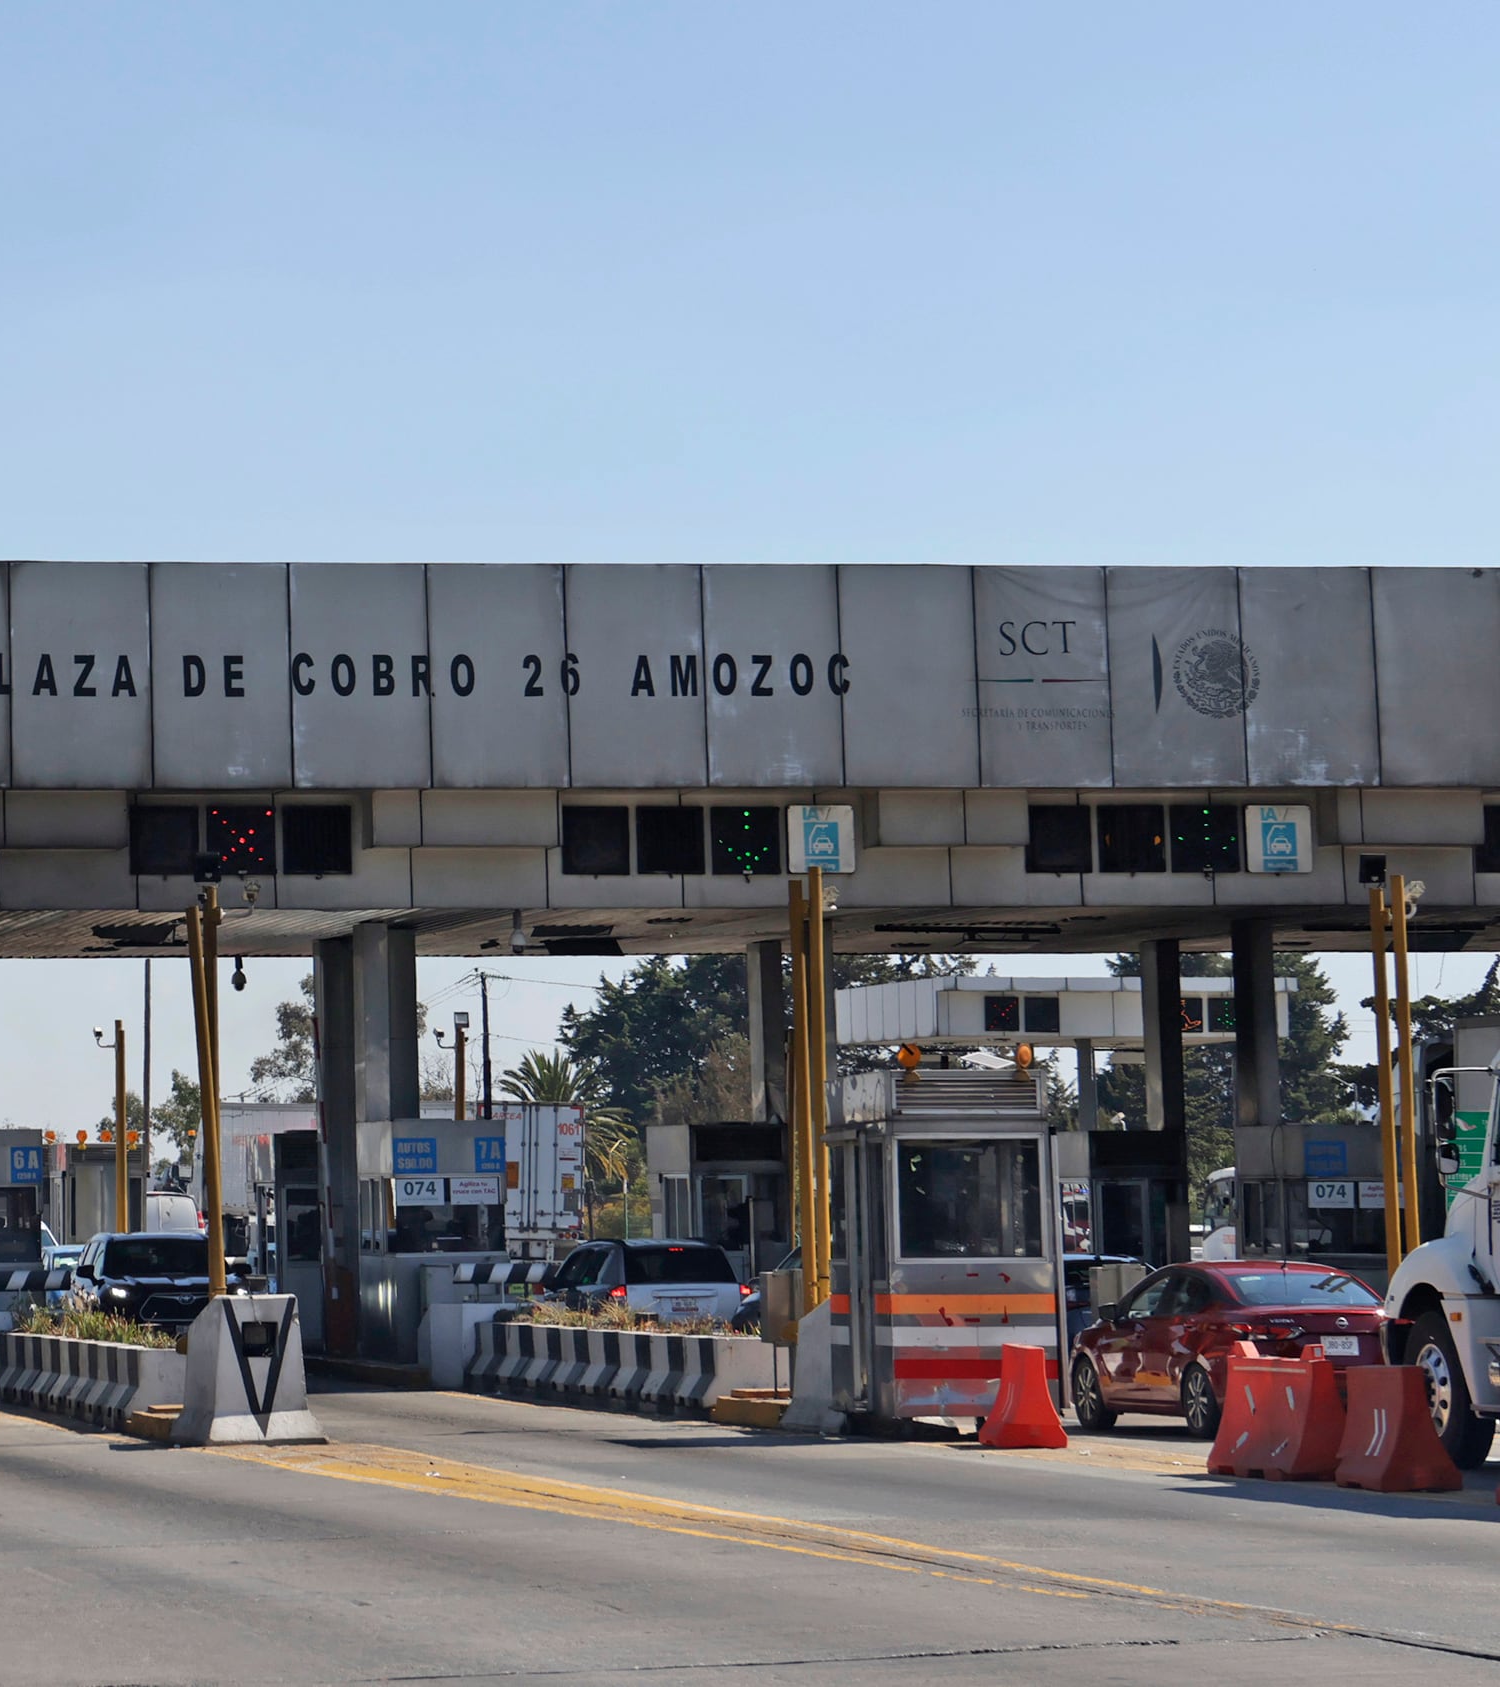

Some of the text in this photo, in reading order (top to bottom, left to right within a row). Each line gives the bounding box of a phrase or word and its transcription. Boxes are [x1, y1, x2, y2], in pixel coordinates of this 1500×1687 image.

[999, 621, 1076, 656] SCT
[182, 654, 245, 698] DE
[292, 653, 476, 698] COBRO
[522, 653, 580, 697] 26
[630, 653, 851, 697] AMOZOC
[1017, 708, 1028, 718] DE
[1031, 708, 1116, 718] COMUNICACIONES
[1025, 721, 1089, 731] TRANSPORTES
[558, 1123, 581, 1136] 1061
[397, 1142, 430, 1153] AUTOS
[478, 1141, 501, 1159] 7 A
[13, 1150, 39, 1169] 6 A
[404, 1181, 437, 1196] 074
[1315, 1184, 1347, 1198] 074
